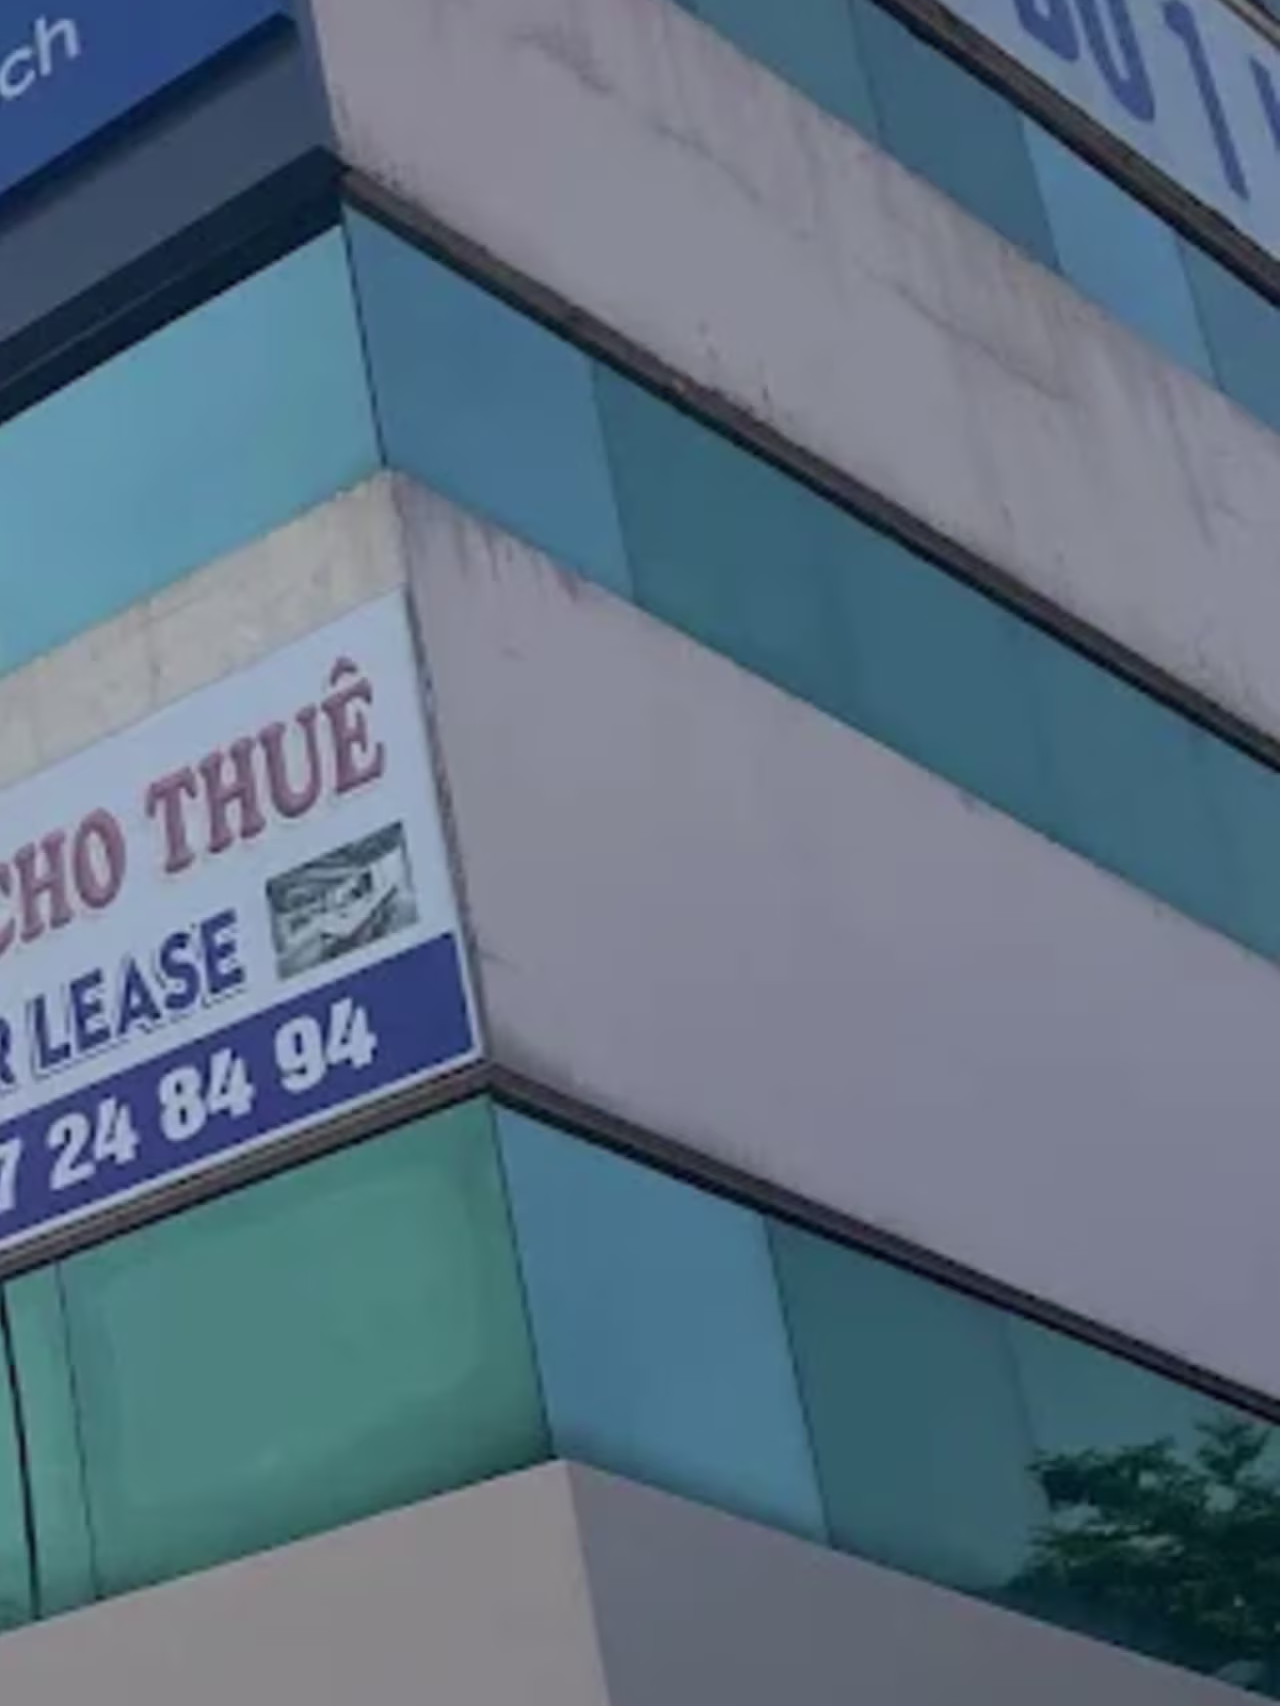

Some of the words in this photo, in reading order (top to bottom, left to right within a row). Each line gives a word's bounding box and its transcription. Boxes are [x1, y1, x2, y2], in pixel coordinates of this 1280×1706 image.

[144, 655, 385, 875] THUÊ
[27, 908, 247, 1079] LEASE
[46, 1097, 139, 1195] 24
[157, 1047, 256, 1142] 84
[273, 995, 378, 1093] 94
